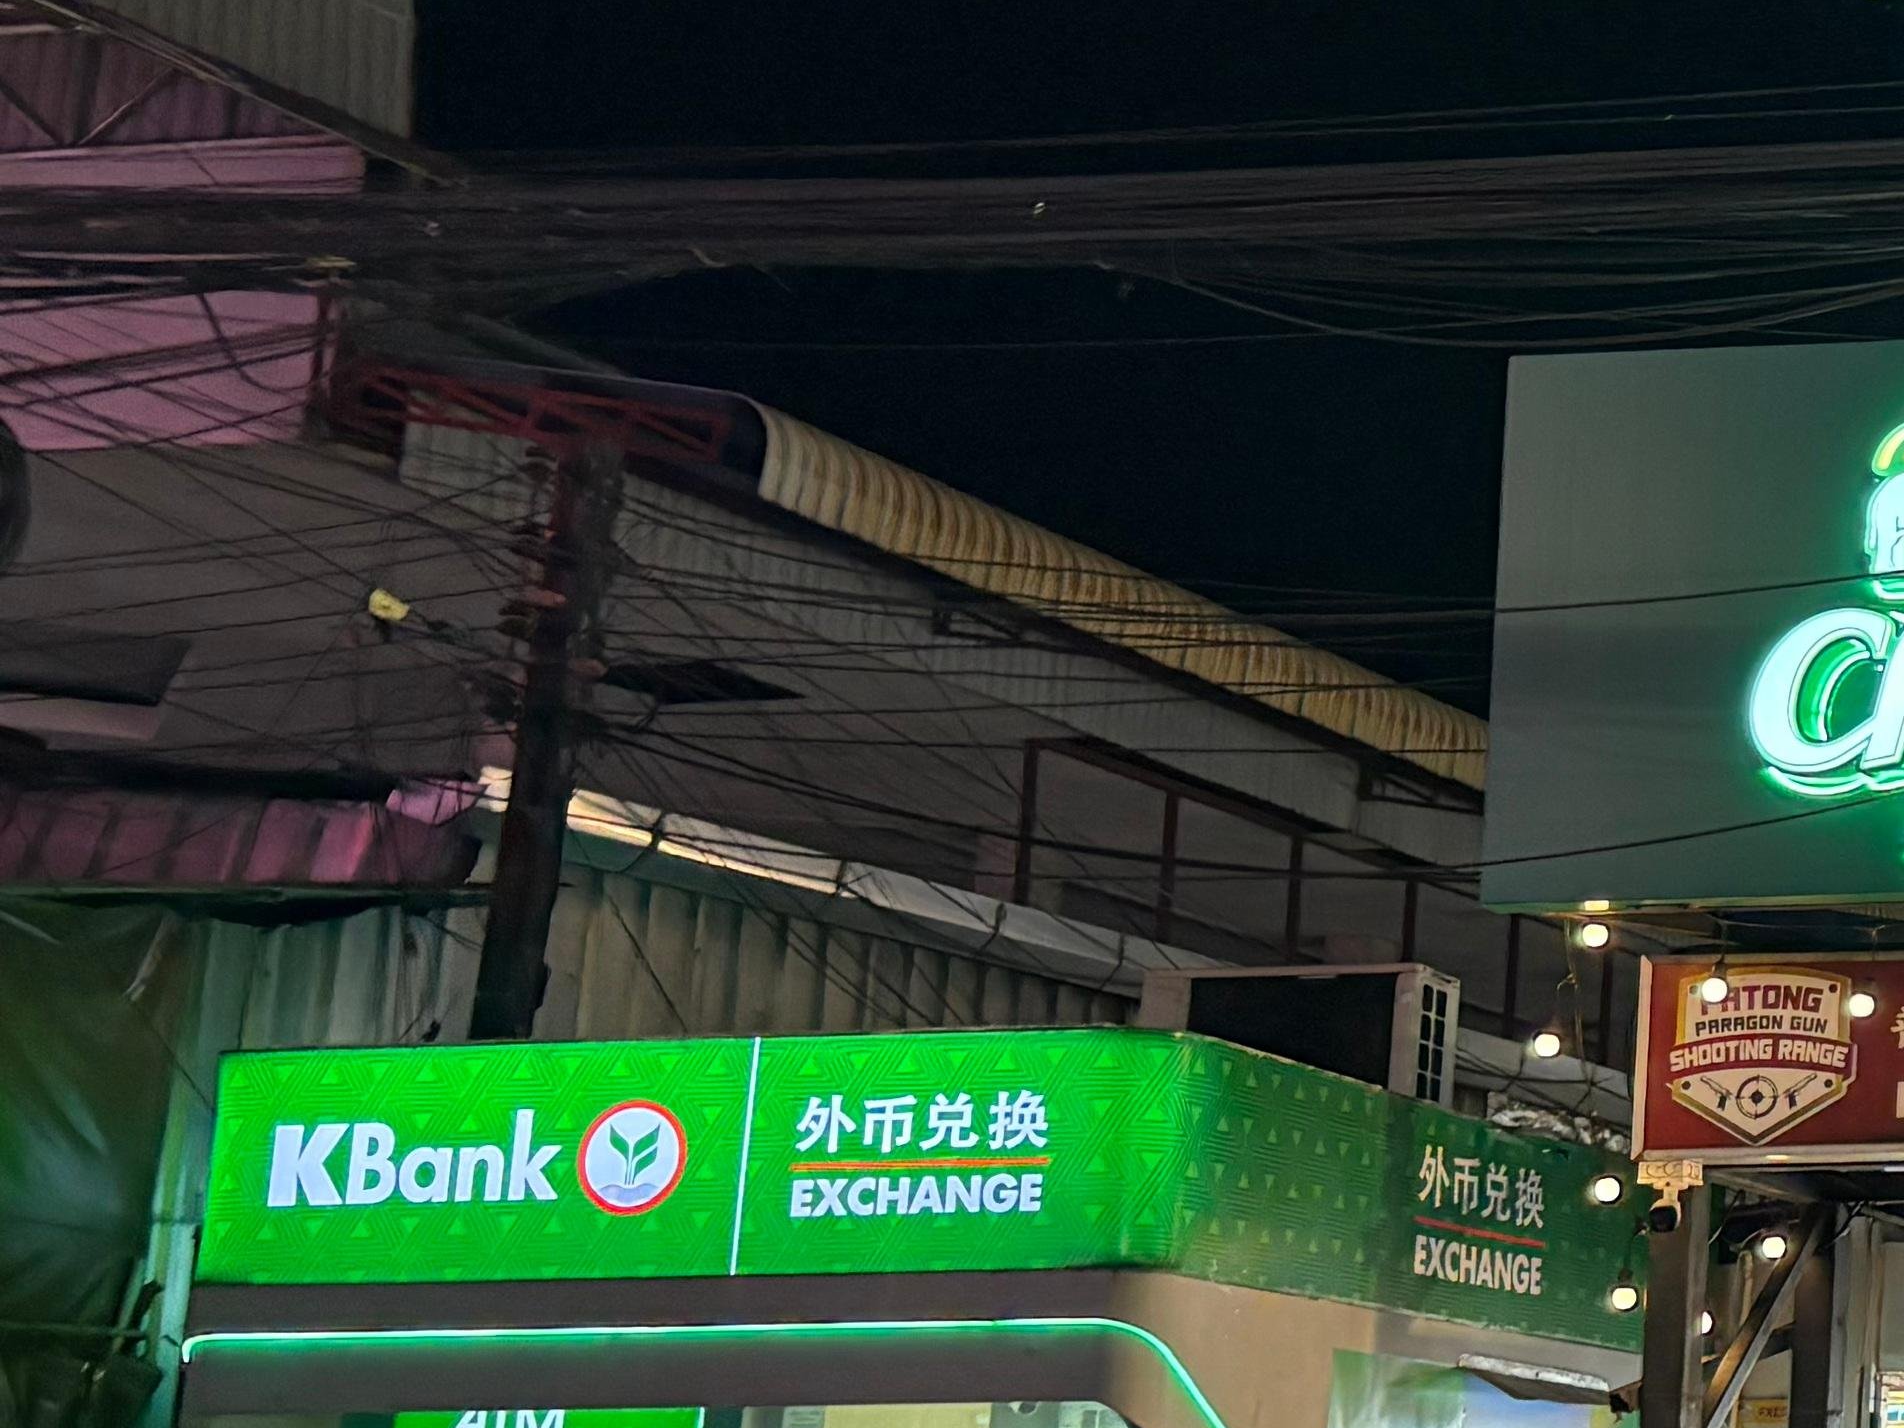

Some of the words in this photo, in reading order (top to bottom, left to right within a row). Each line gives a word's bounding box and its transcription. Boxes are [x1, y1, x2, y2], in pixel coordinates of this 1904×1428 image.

[1695, 1016, 1787, 1034] PARAGON
[1790, 1015, 1828, 1034] GUN
[1669, 1043, 1774, 1073] SHOOTING
[1777, 1042, 1849, 1069] RANGE
[795, 1087, 1050, 1157] 外币兑换
[267, 1108, 559, 1208] KBank
[1418, 1143, 1545, 1229] 外币兑换
[789, 1172, 1044, 1220] EXCHANGE
[1413, 1233, 1543, 1296] EXCHANGE
